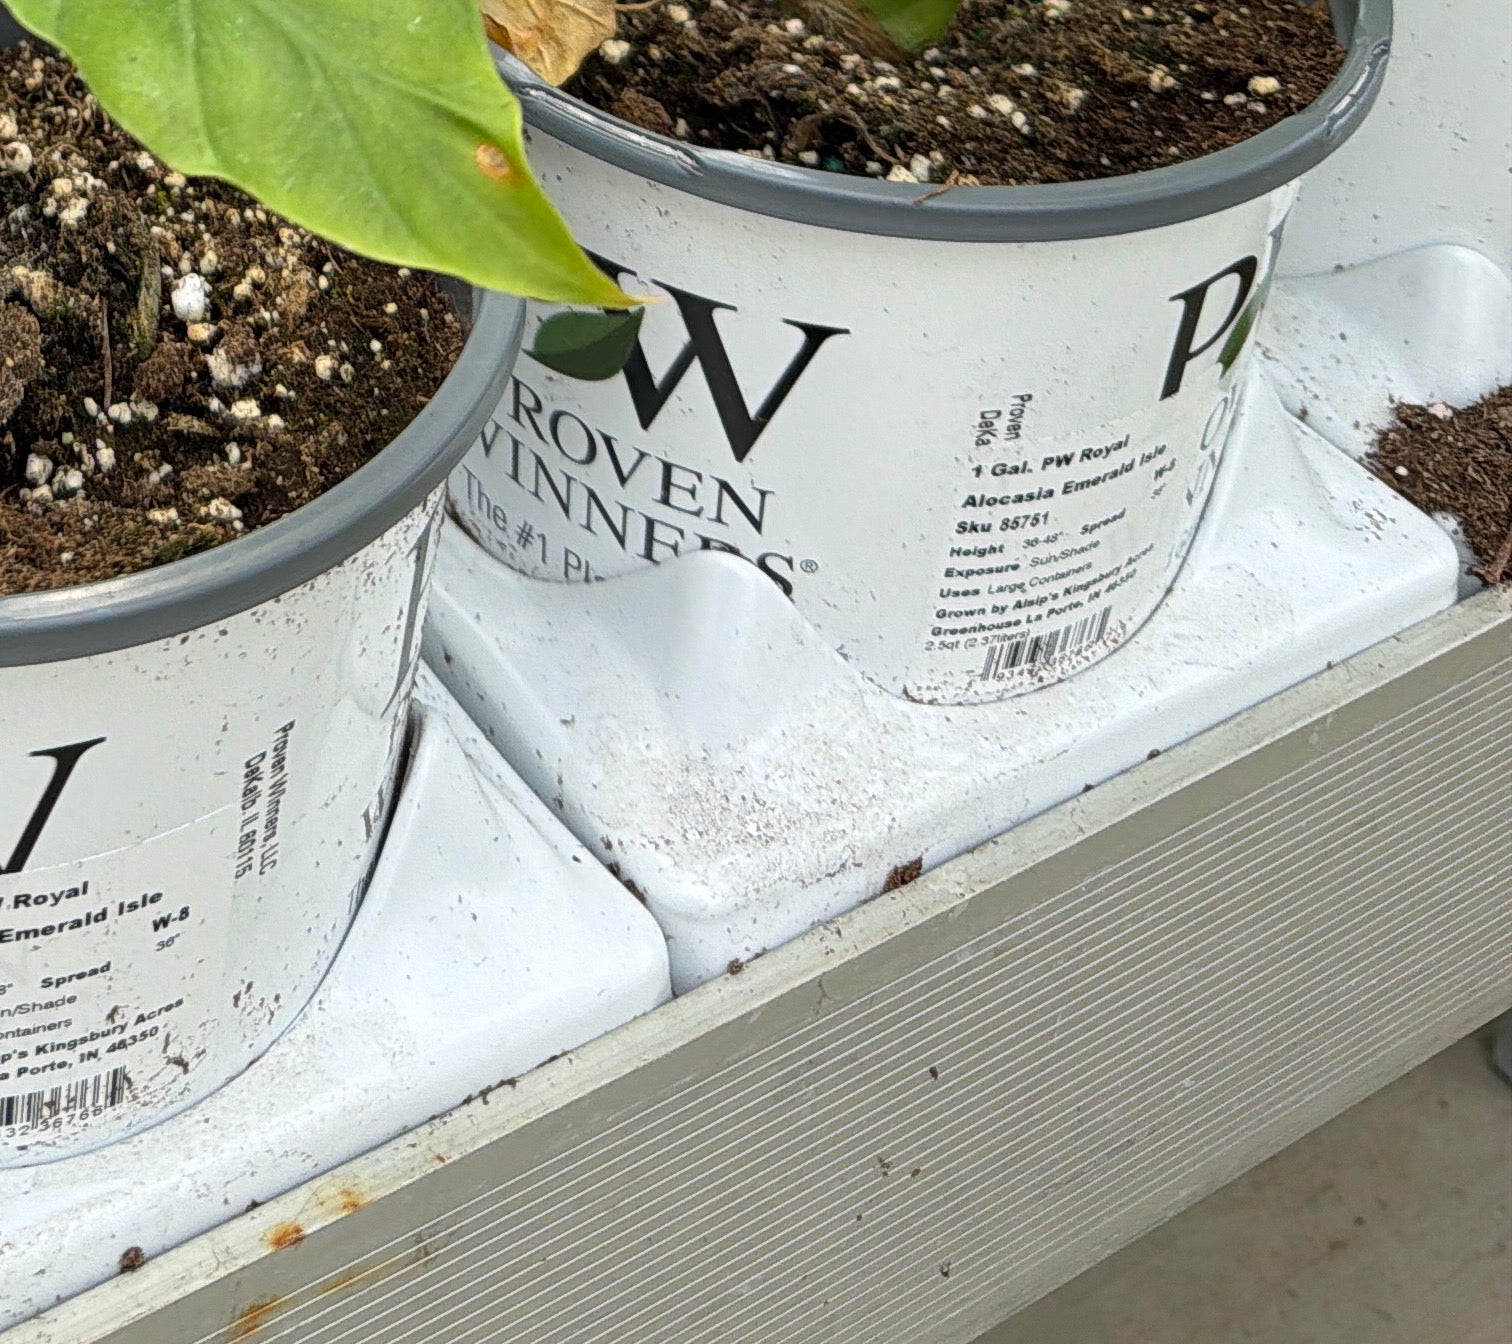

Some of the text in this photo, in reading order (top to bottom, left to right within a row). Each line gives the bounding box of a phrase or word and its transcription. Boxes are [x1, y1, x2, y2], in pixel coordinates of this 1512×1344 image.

[576, 244, 851, 463] W
[1004, 393, 1033, 441] Proven
[510, 374, 775, 535] ROVEN
[962, 487, 1055, 508] Alocasia
[1061, 458, 1135, 495] Emerald
[1139, 444, 1167, 466] Isle
[972, 434, 1130, 478] 1 Gal. PW Royal
[516, 520, 550, 564] #1
[949, 544, 1005, 558] Height
[1080, 508, 1127, 536] Spread
[955, 517, 992, 534] Sku
[999, 511, 1050, 531] 85751
[939, 561, 1093, 599] Uses Large Containers
[944, 539, 1100, 579] Exposure Sun/Shade
[935, 607, 986, 619] Grown
[990, 603, 1008, 615] by
[1012, 591, 1059, 611] Alsip's
[1062, 566, 1122, 597] Kingsbury
[924, 639, 962, 651] 2.5qt
[931, 617, 1021, 637] Greenhouse
[1025, 612, 1043, 624] La
[270, 719, 296, 779] Proven
[234, 829, 257, 880] 60115
[13, 881, 89, 910] Royal
[118, 890, 163, 916] Isle
[152, 905, 190, 932] W-8
[40, 960, 112, 989] Spread
[35, 1022, 128, 1054] Kingsbury
[133, 997, 184, 1028] Acres
[16, 1059, 73, 1079] Porte,
[106, 1025, 159, 1053] 46350
